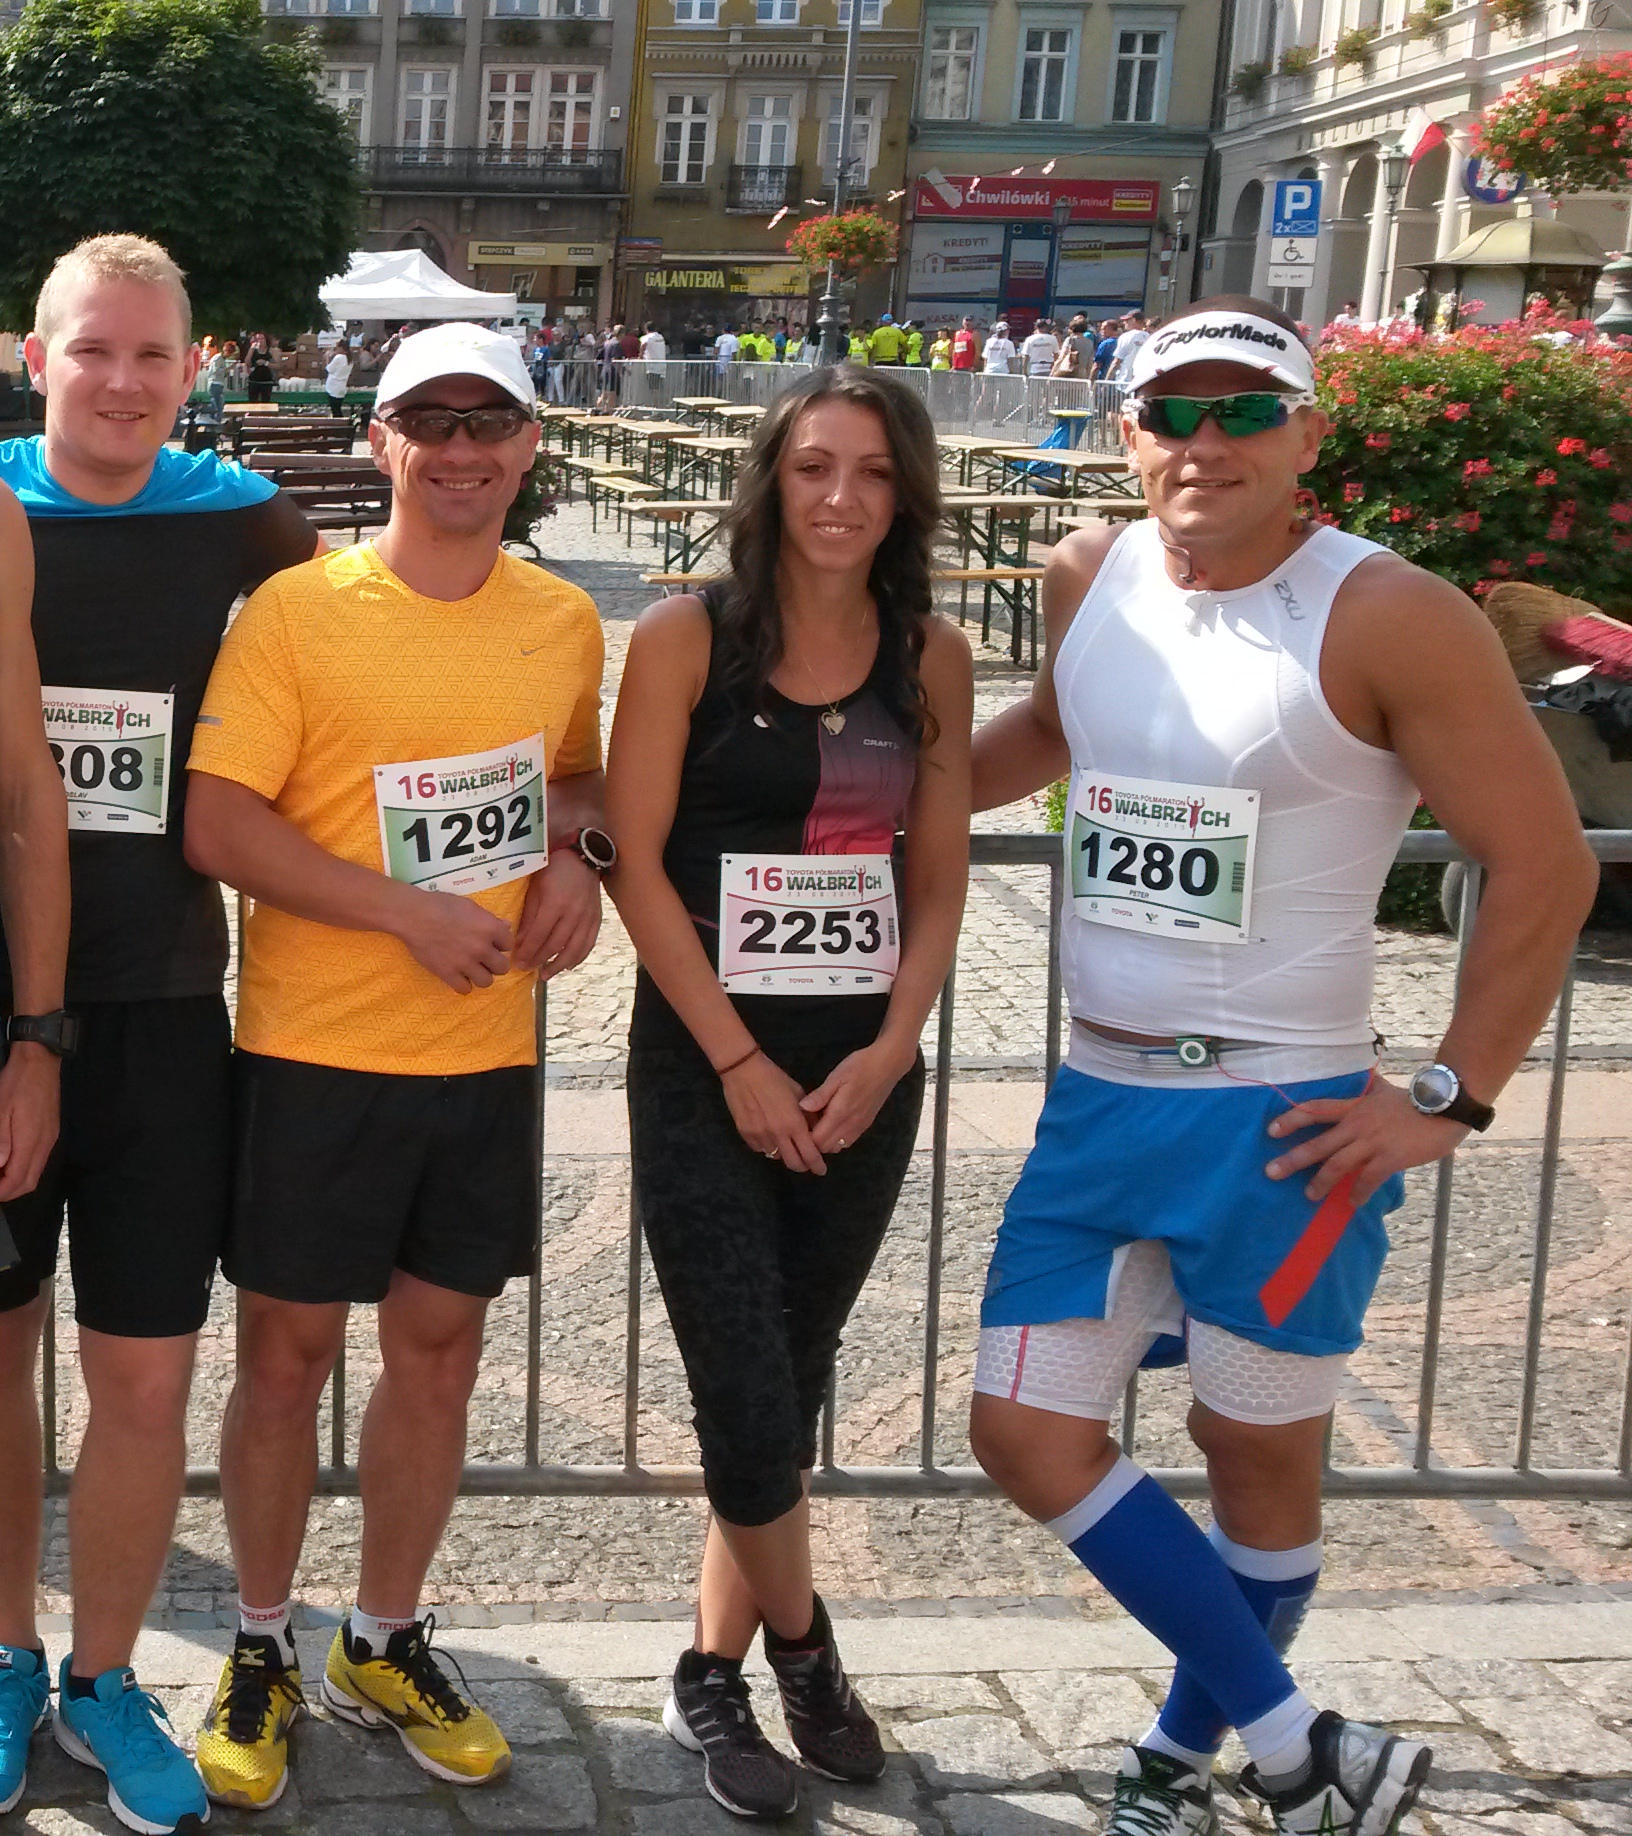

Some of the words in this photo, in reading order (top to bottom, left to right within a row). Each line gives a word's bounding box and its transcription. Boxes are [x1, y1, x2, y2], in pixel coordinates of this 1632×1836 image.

[966, 189, 1050, 205] Chwilówki
[1284, 185, 1312, 219] P
[645, 270, 725, 289] GALANTERIA
[1154, 323, 1287, 355] TaylorMade
[863, 739, 893, 748] CRAFT
[397, 772, 436, 800] 16
[1088, 785, 1112, 813] 16
[1115, 791, 1139, 799] TOYOTA
[402, 795, 532, 862] 1292
[1080, 831, 1220, 897] 1280
[745, 867, 783, 891] 16
[739, 909, 882, 954] 2253
